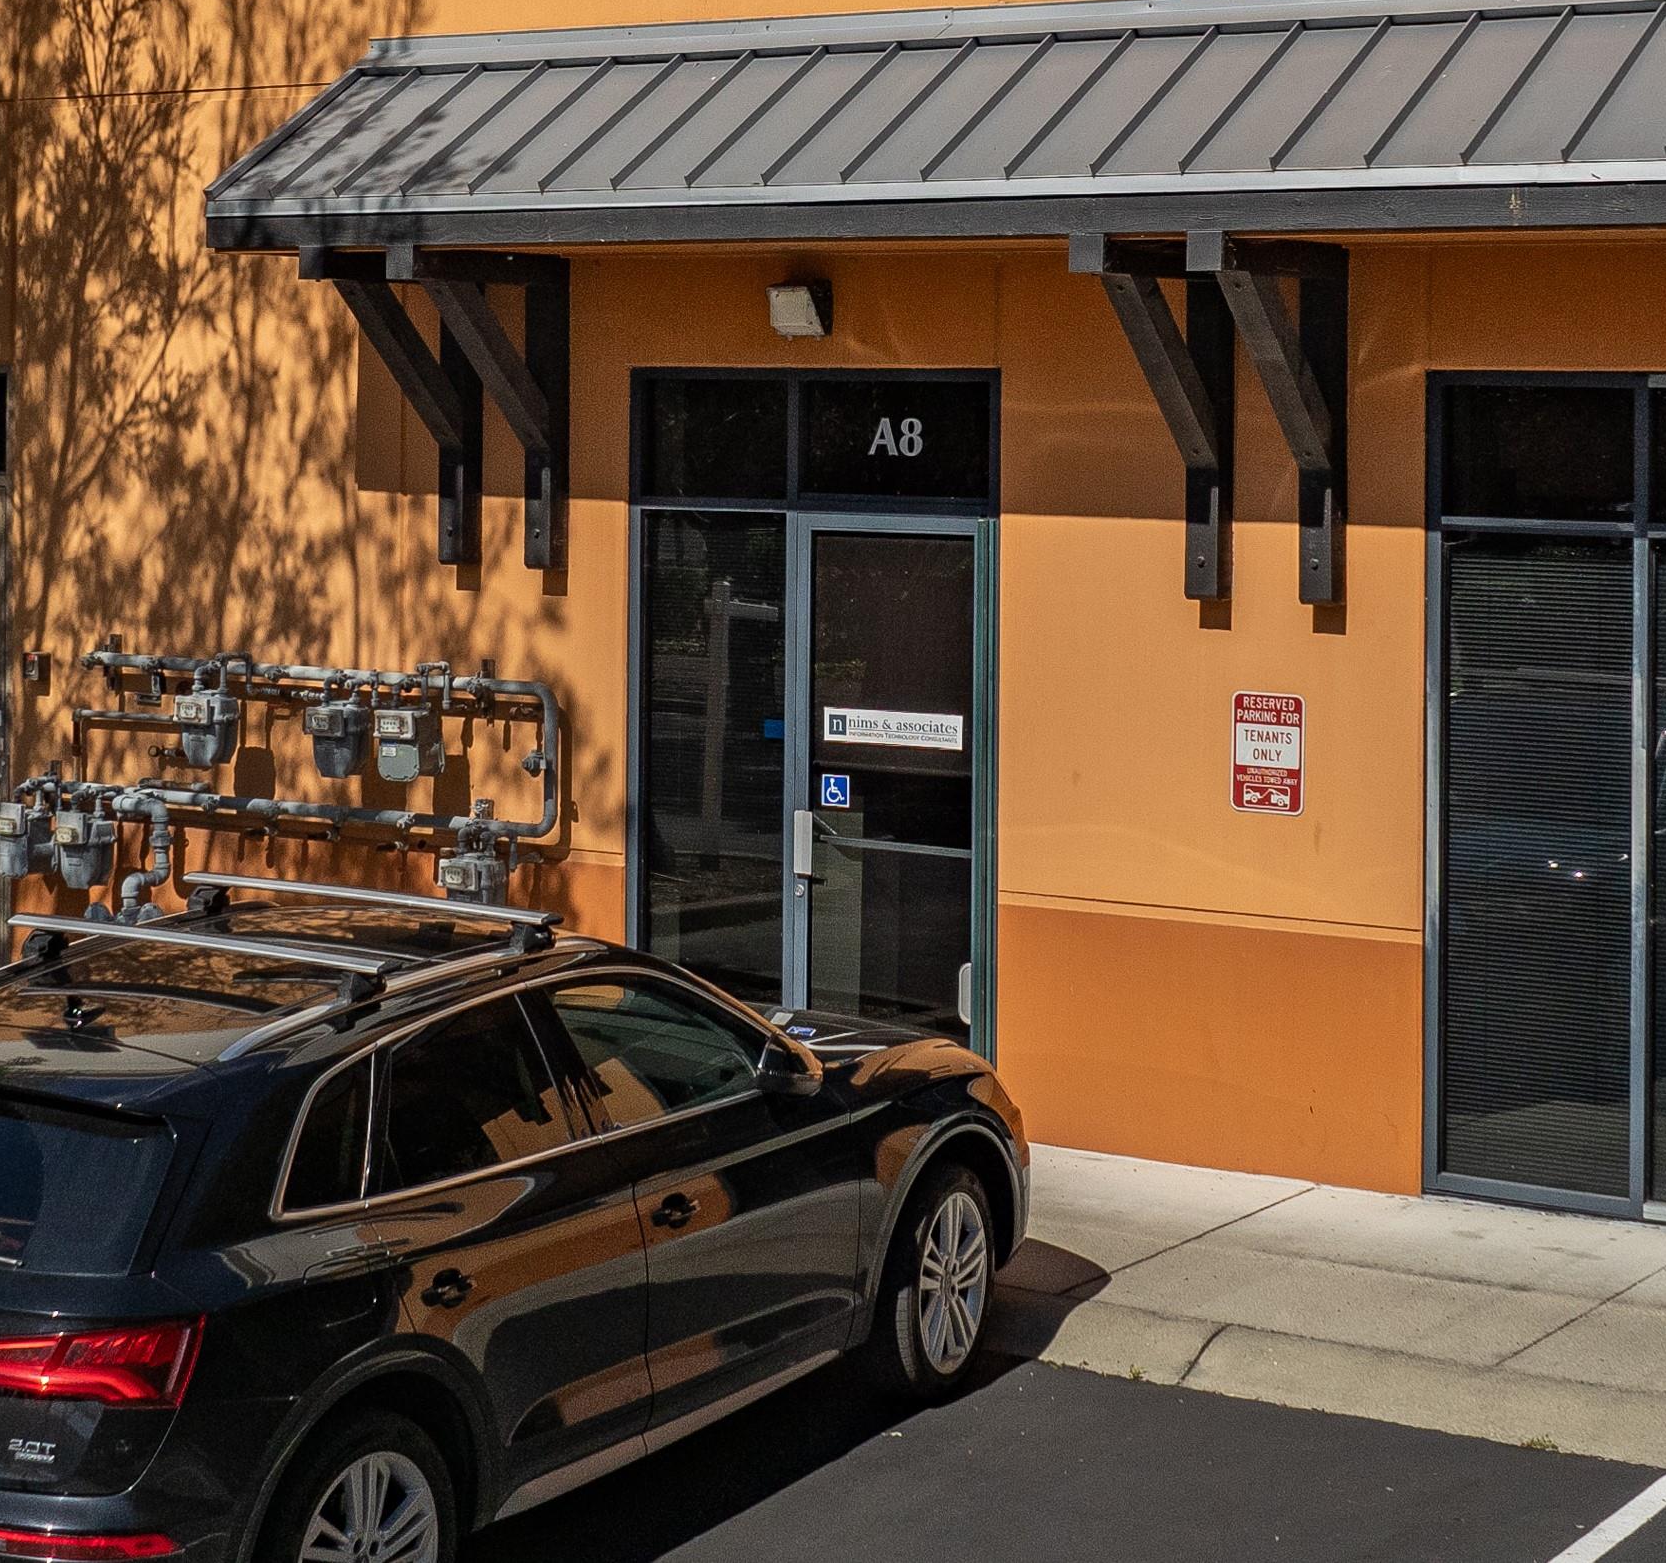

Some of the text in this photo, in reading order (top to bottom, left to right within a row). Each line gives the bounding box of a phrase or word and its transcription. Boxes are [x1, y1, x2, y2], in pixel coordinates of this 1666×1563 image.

[867, 417, 923, 457] A8
[1243, 696, 1295, 711] RESERVED
[848, 715, 958, 734] nims & associates
[1237, 709, 1300, 725] PARKING FOR
[1244, 729, 1293, 745] TENANTS
[1253, 748, 1282, 762] ONLY
[8, 1438, 56, 1454] 2.0T
